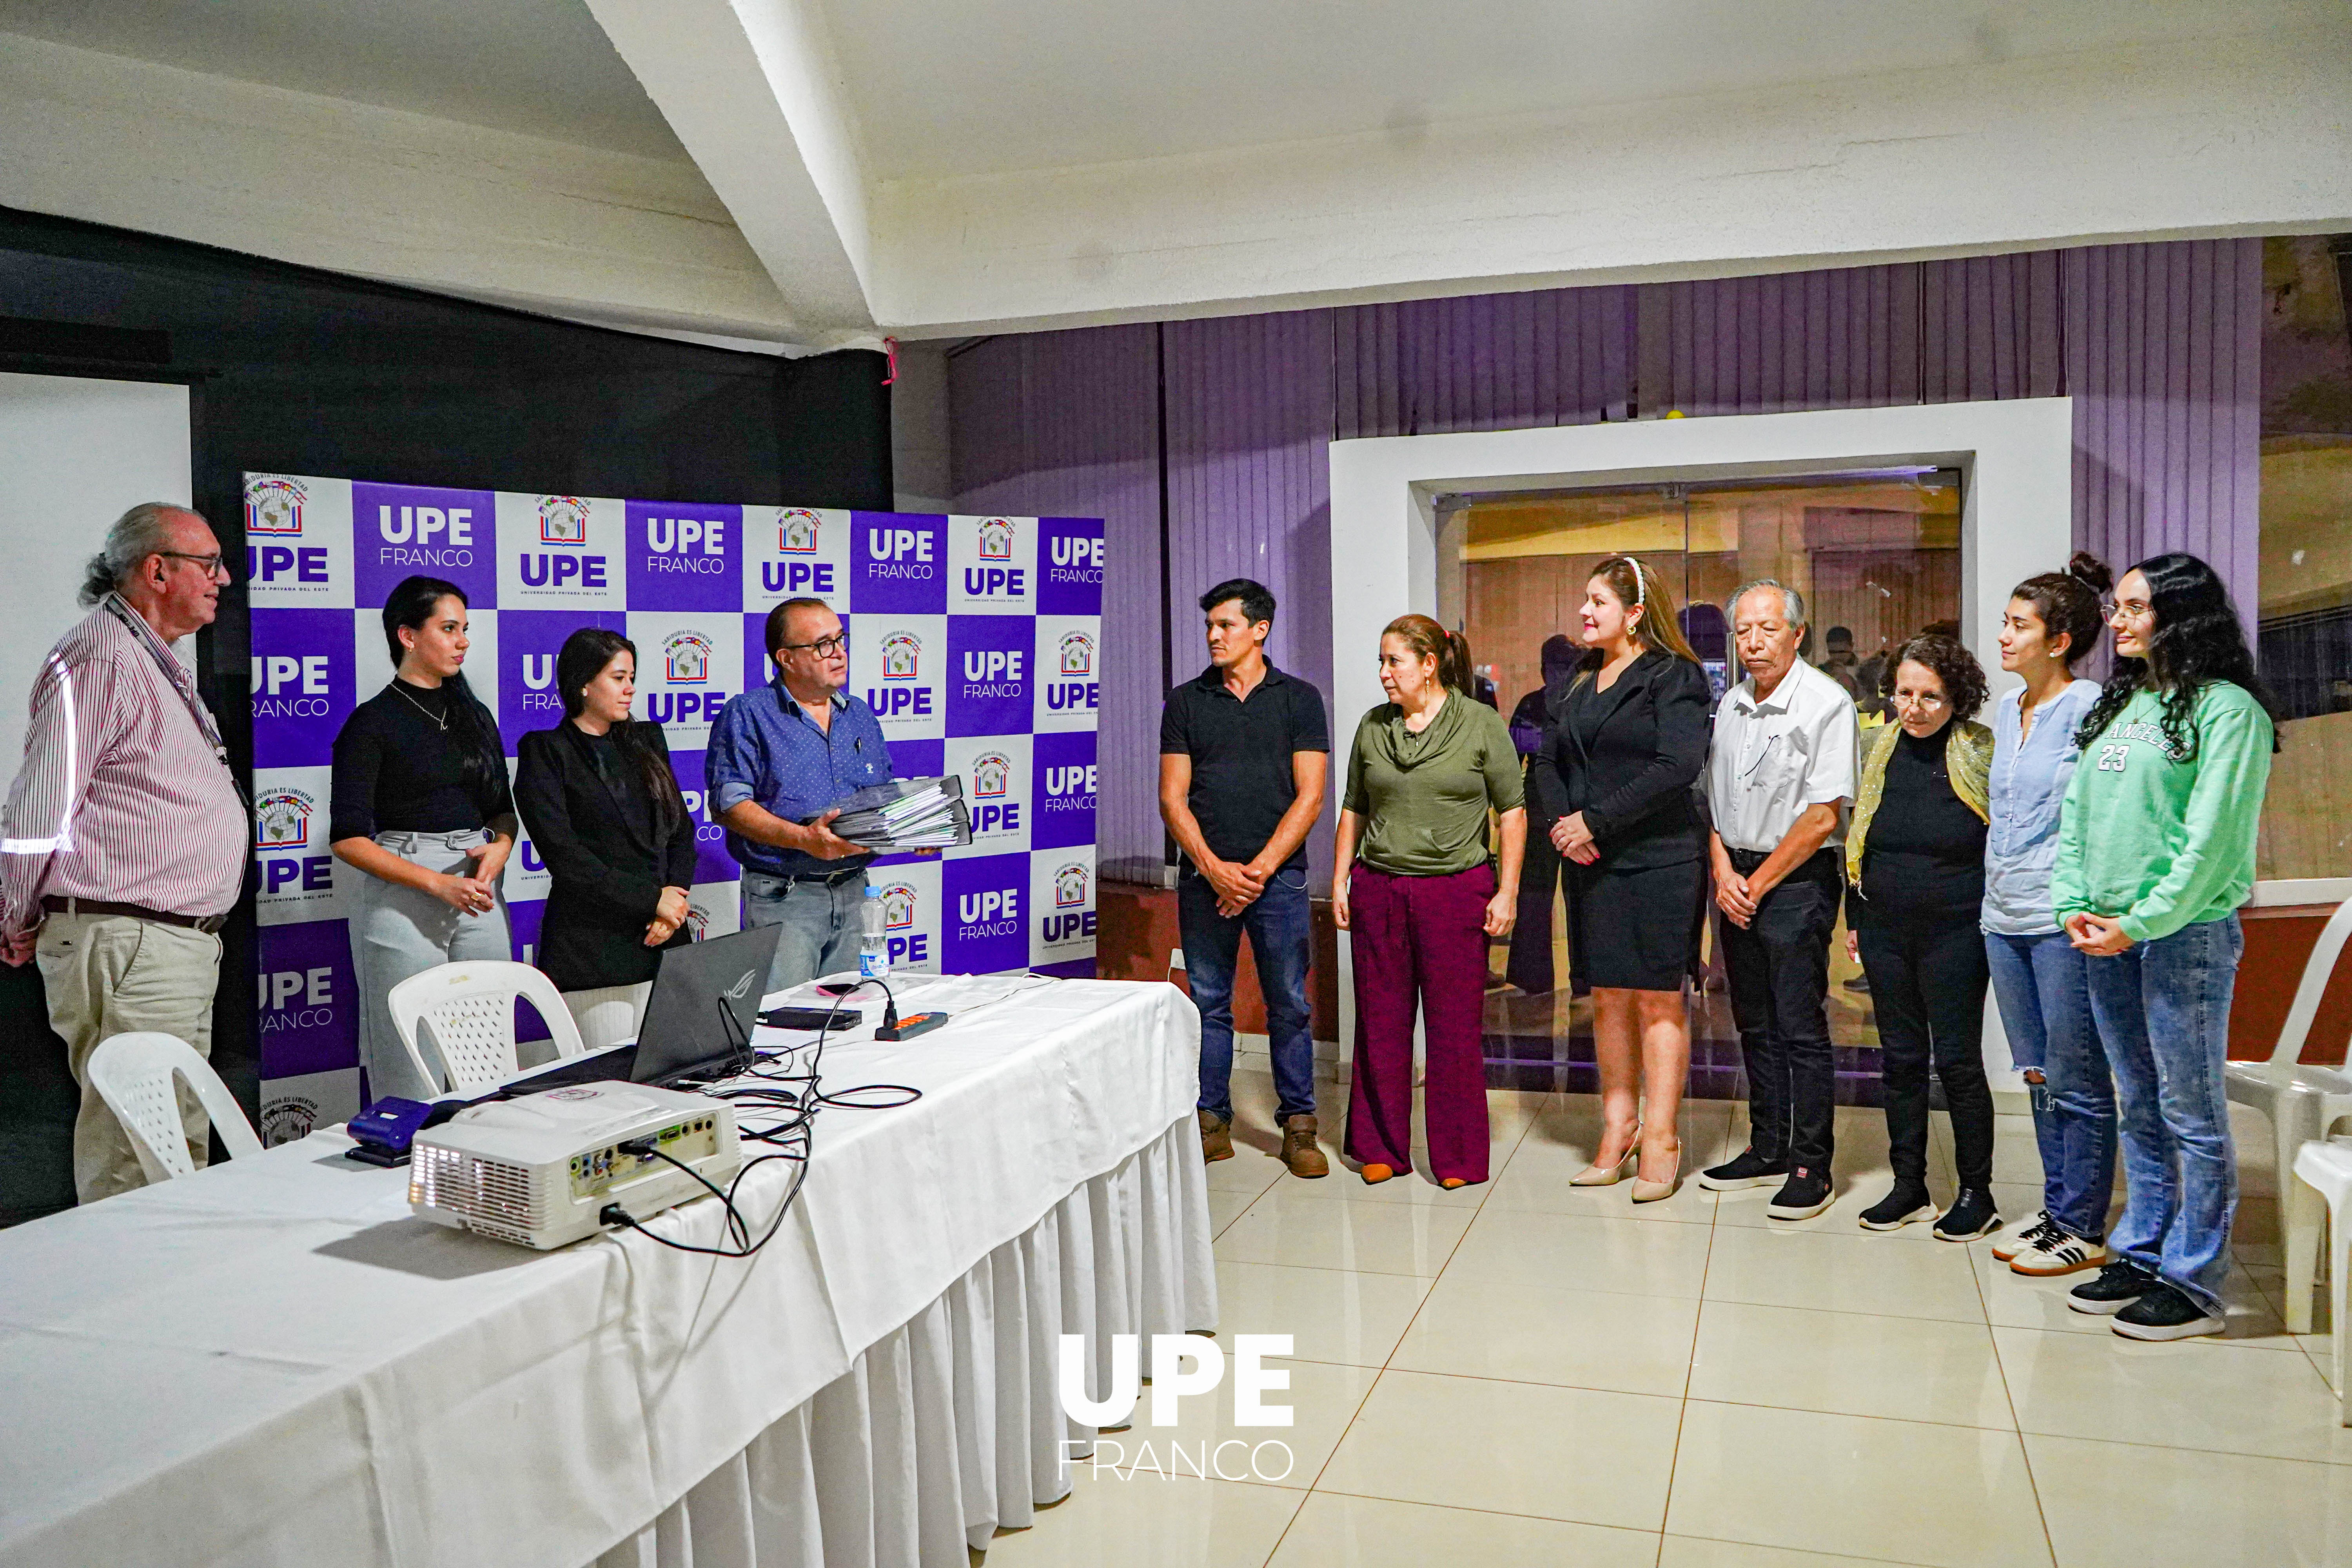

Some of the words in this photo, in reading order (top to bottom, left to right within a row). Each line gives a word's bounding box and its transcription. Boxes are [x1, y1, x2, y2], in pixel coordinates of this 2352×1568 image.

[379, 505, 472, 545] UPE
[648, 518, 724, 555] UPE
[381, 548, 473, 566] FRANCO
[869, 528, 933, 561] UPE
[1051, 537, 1104, 567] UPE
[521, 554, 606, 587] UPE
[648, 556, 724, 574] FRANCO
[762, 562, 833, 592] UPE
[869, 564, 933, 579] FRANCO
[1051, 569, 1103, 583] FRANCO
[965, 568, 1024, 595] UPE
[964, 651, 1022, 681] UPE
[523, 694, 563, 710] FRA
[867, 688, 931, 717] UPE
[964, 683, 1022, 698] FRANCO
[1047, 683, 1099, 710] UPE
[250, 699, 329, 717] RANCO
[648, 692, 725, 724] UPE
[2098, 744, 2130, 772] 23
[1046, 765, 1096, 796] UPE
[255, 788, 278, 801] IDURIA
[288, 788, 314, 803] LIBERTAD
[256, 856, 332, 894] PE
[960, 889, 1017, 923] UPE
[959, 920, 1017, 940] FRANCO
[1043, 911, 1096, 942] UPE
[887, 934, 927, 965] PE
[259, 1009, 332, 1033] ANCO
